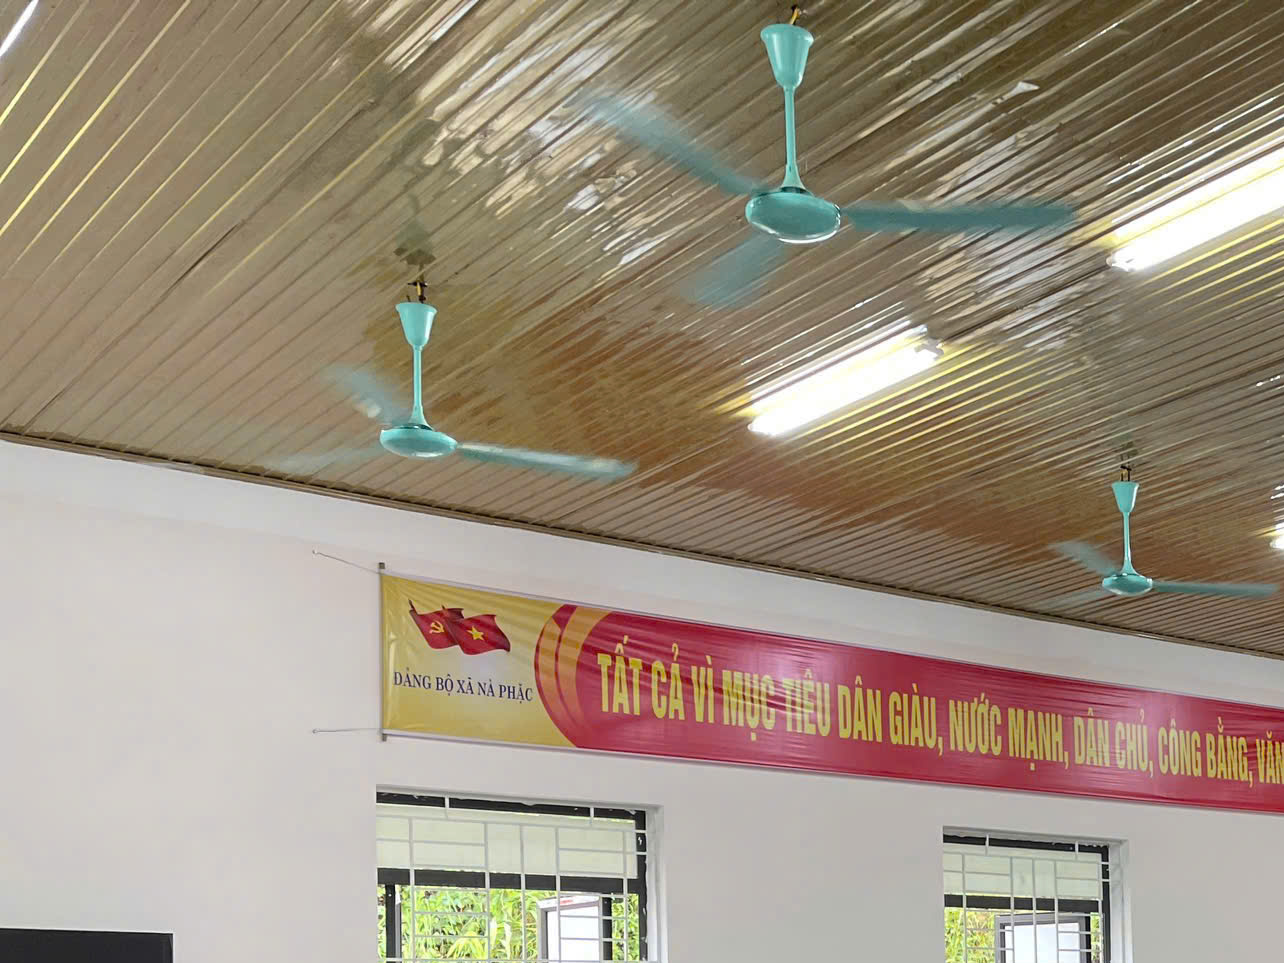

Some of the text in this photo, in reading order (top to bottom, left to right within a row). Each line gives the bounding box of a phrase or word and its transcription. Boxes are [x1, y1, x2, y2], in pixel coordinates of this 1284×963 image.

[393, 667, 431, 689] ĐẢNG
[436, 674, 454, 696] BỘ
[477, 679, 495, 697] NÀ
[499, 683, 533, 704] PHẶC
[597, 635, 644, 717] TẤT
[652, 643, 686, 721] CẢ
[690, 655, 716, 724] VÌ
[722, 670, 775, 741] MỤC
[782, 668, 831, 736] TIÊU
[838, 675, 882, 742] DÂN
[889, 682, 944, 756] GIÀU,
[949, 691, 1002, 756] NƯỚC
[1008, 707, 1069, 771] MẠNH,
[1074, 706, 1110, 768] DÂN
[1115, 708, 1154, 777] CHỦ,
[1158, 724, 1202, 777] CÔNG
[1206, 716, 1253, 788] BẰNG,
